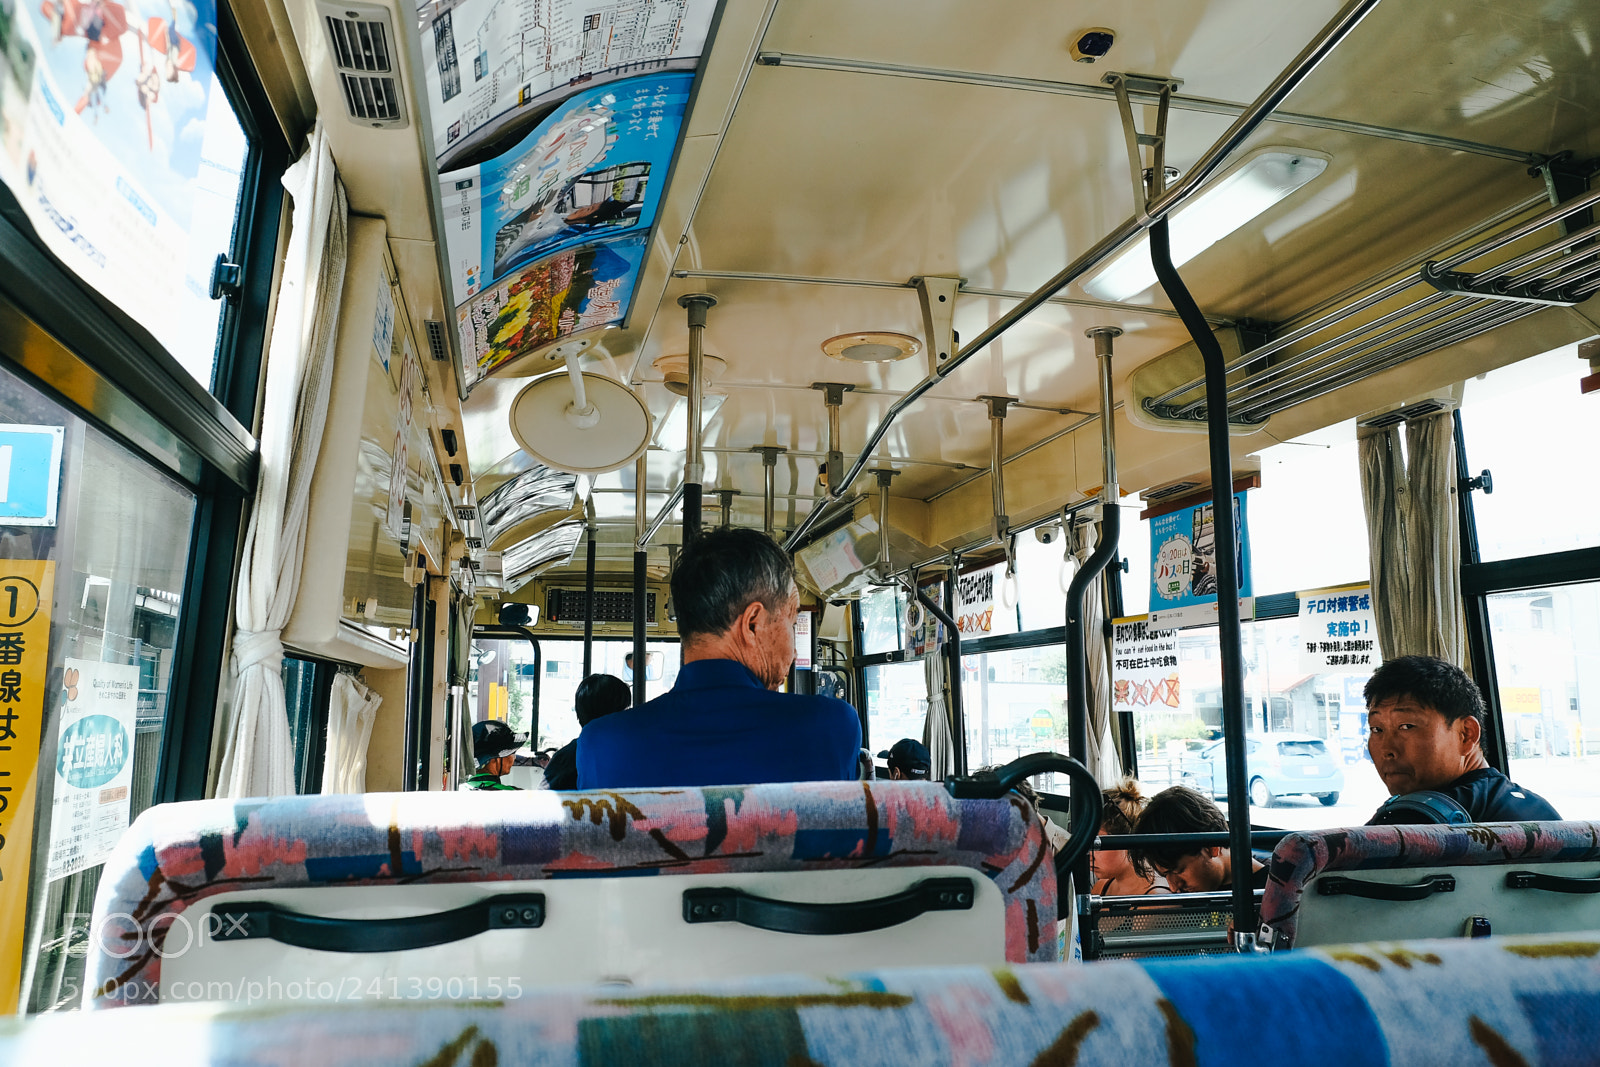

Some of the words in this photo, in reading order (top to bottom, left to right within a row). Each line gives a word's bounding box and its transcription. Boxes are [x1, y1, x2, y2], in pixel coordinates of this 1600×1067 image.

[1158, 560, 1190, 579] バスの日
[1307, 594, 1370, 614] テロ対策警戒
[1115, 647, 1123, 656] You
[1145, 644, 1153, 653] food
[1115, 655, 1177, 670] 不可在巴士中吃食物
[62, 732, 123, 772] 共立産婦人科
